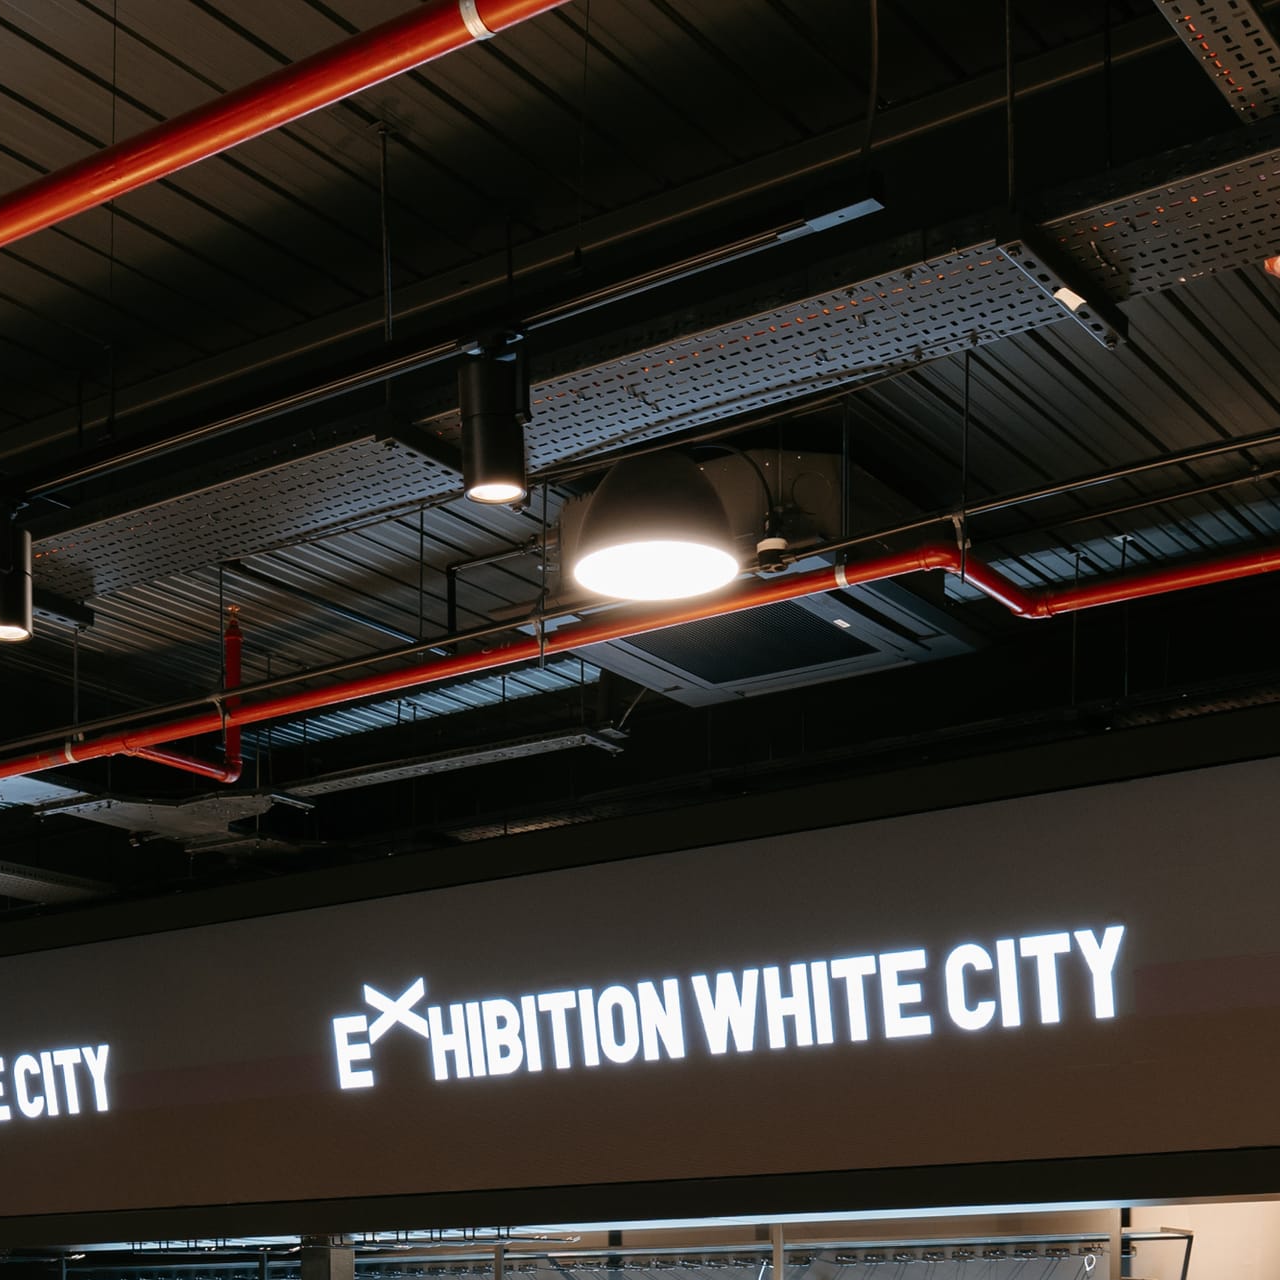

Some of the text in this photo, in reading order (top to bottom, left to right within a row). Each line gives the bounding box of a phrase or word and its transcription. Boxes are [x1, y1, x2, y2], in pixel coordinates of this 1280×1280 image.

[332, 925, 1125, 1089] EXHIBITION WHITE CITY
[14, 1045, 110, 1118] CITY
